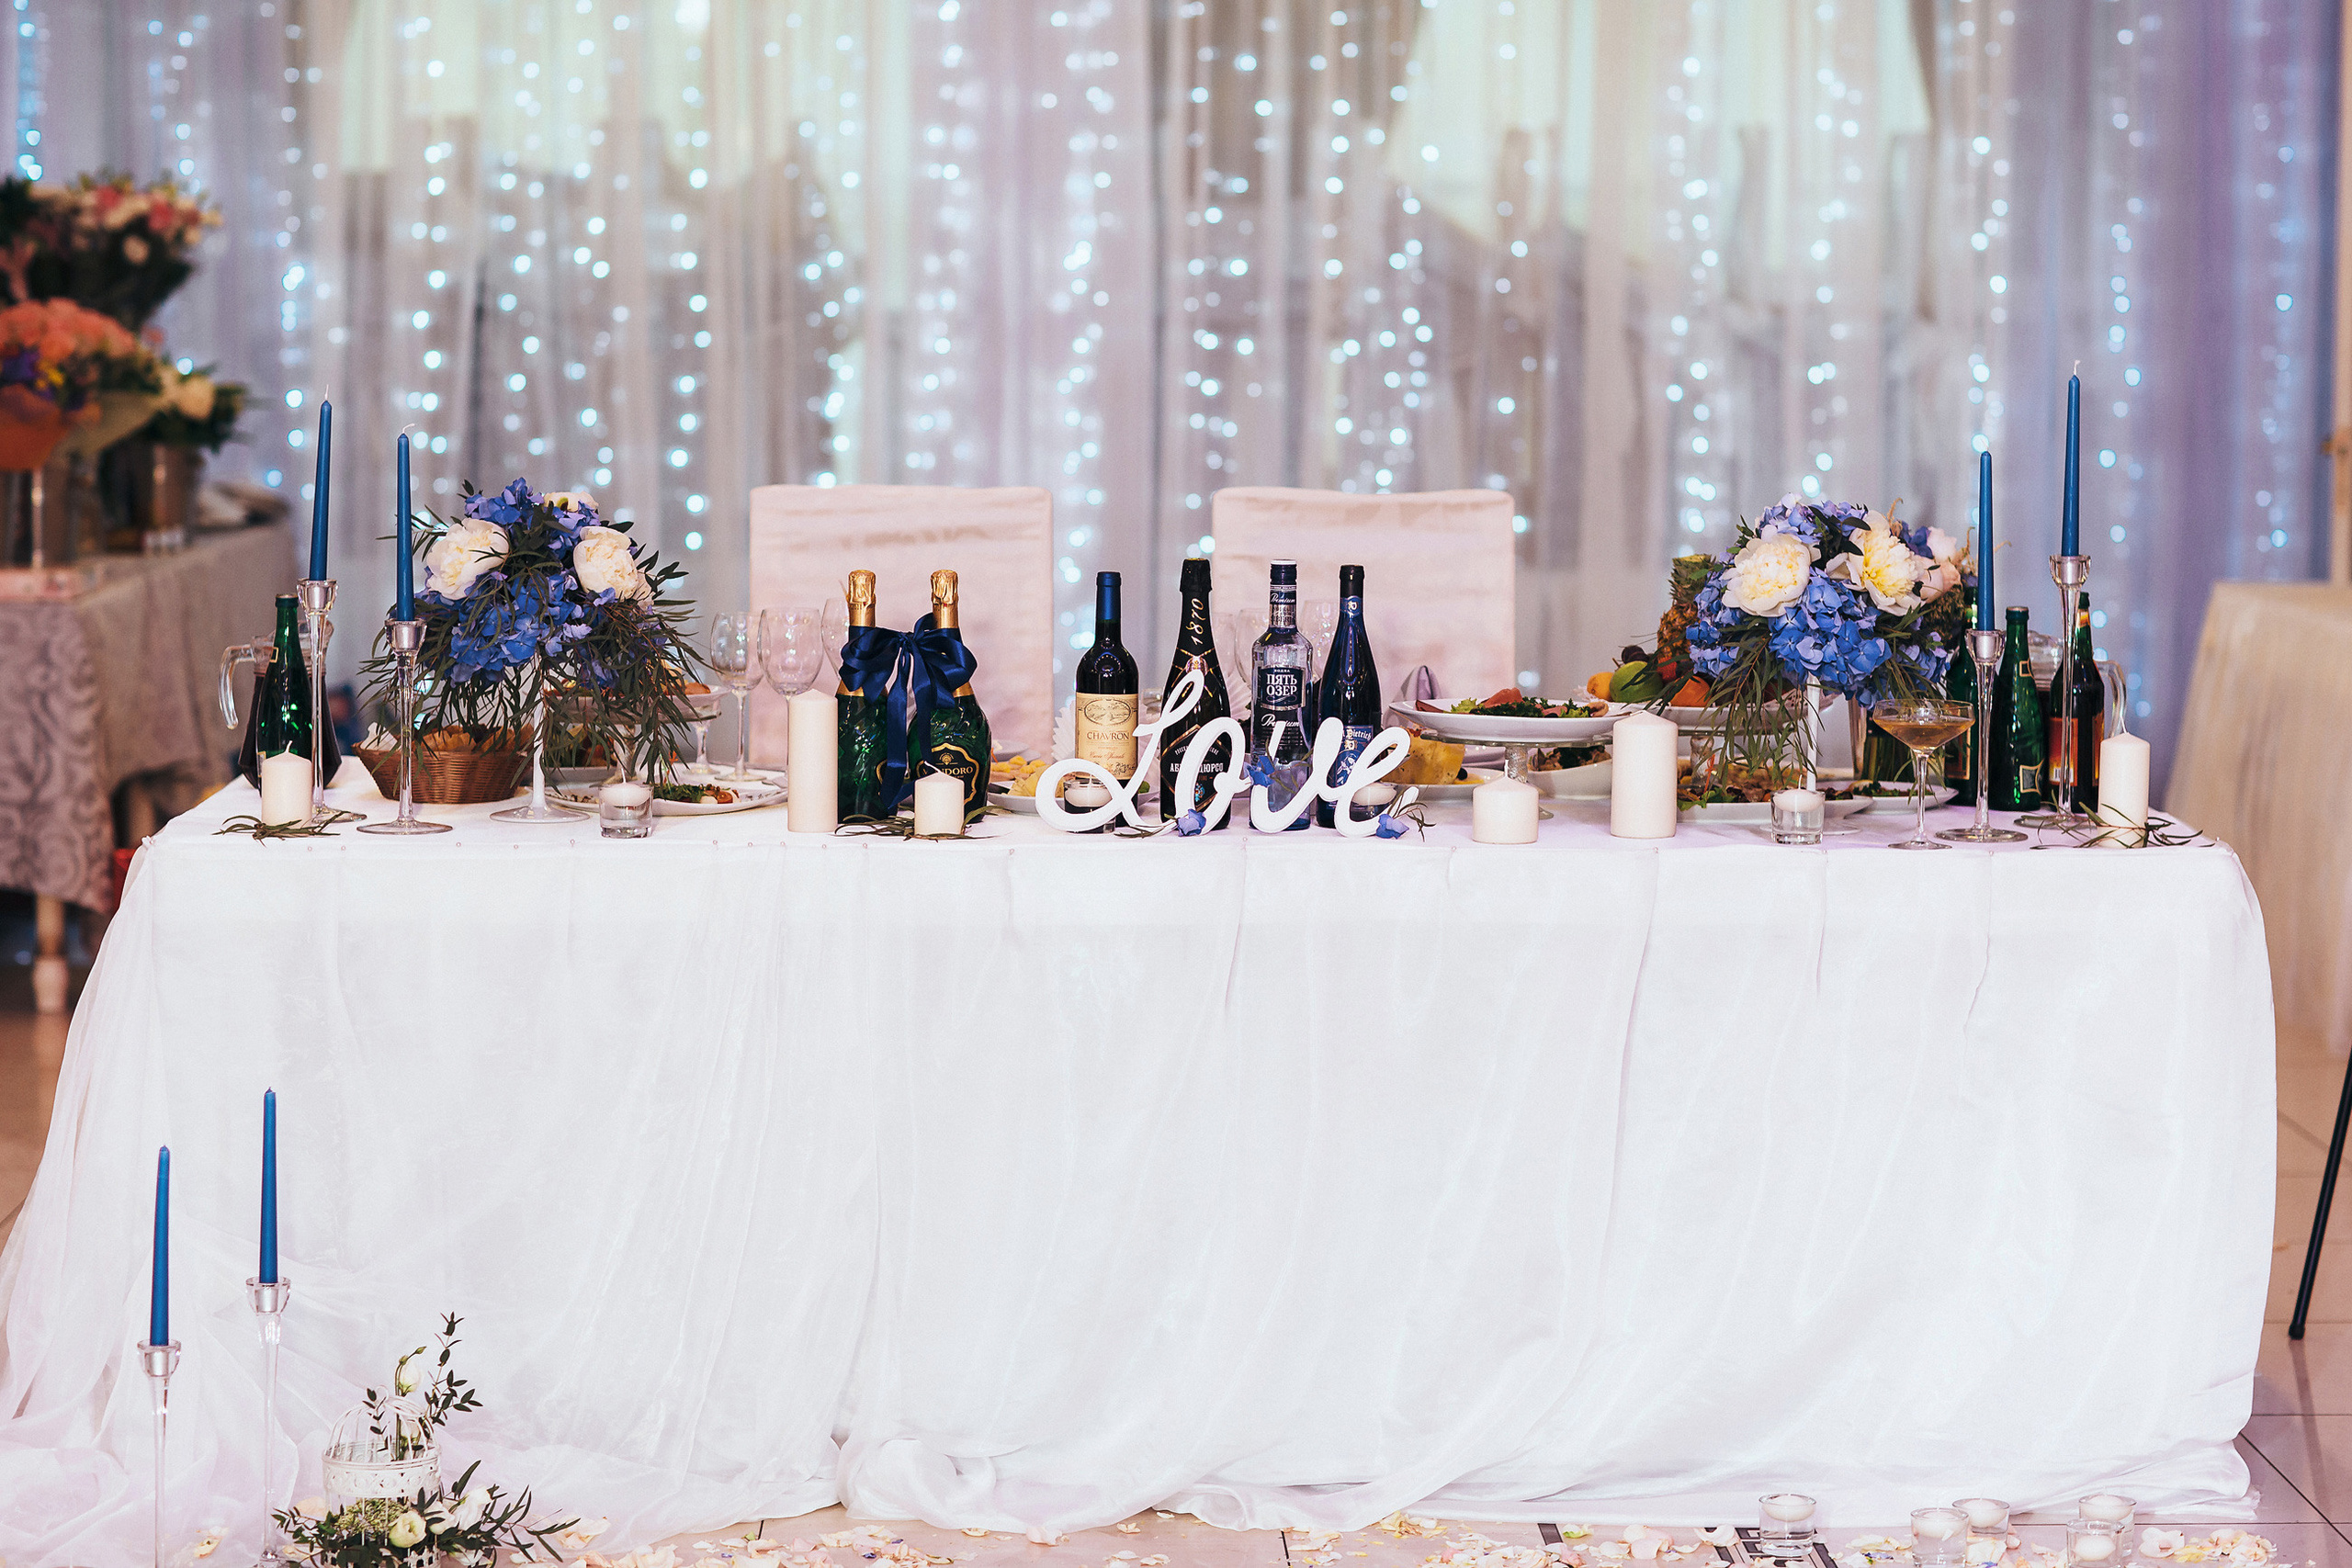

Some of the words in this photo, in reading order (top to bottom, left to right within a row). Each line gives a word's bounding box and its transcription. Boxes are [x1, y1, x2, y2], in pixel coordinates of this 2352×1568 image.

[1185, 598, 1205, 646] 1870
[1266, 673, 1298, 685] ПЯТЬ
[1266, 684, 1297, 696] ОЗЕР
[1261, 713, 1300, 727] Preium
[1086, 731, 1130, 740] CHAVRON
[1035, 669, 1419, 838] Love
